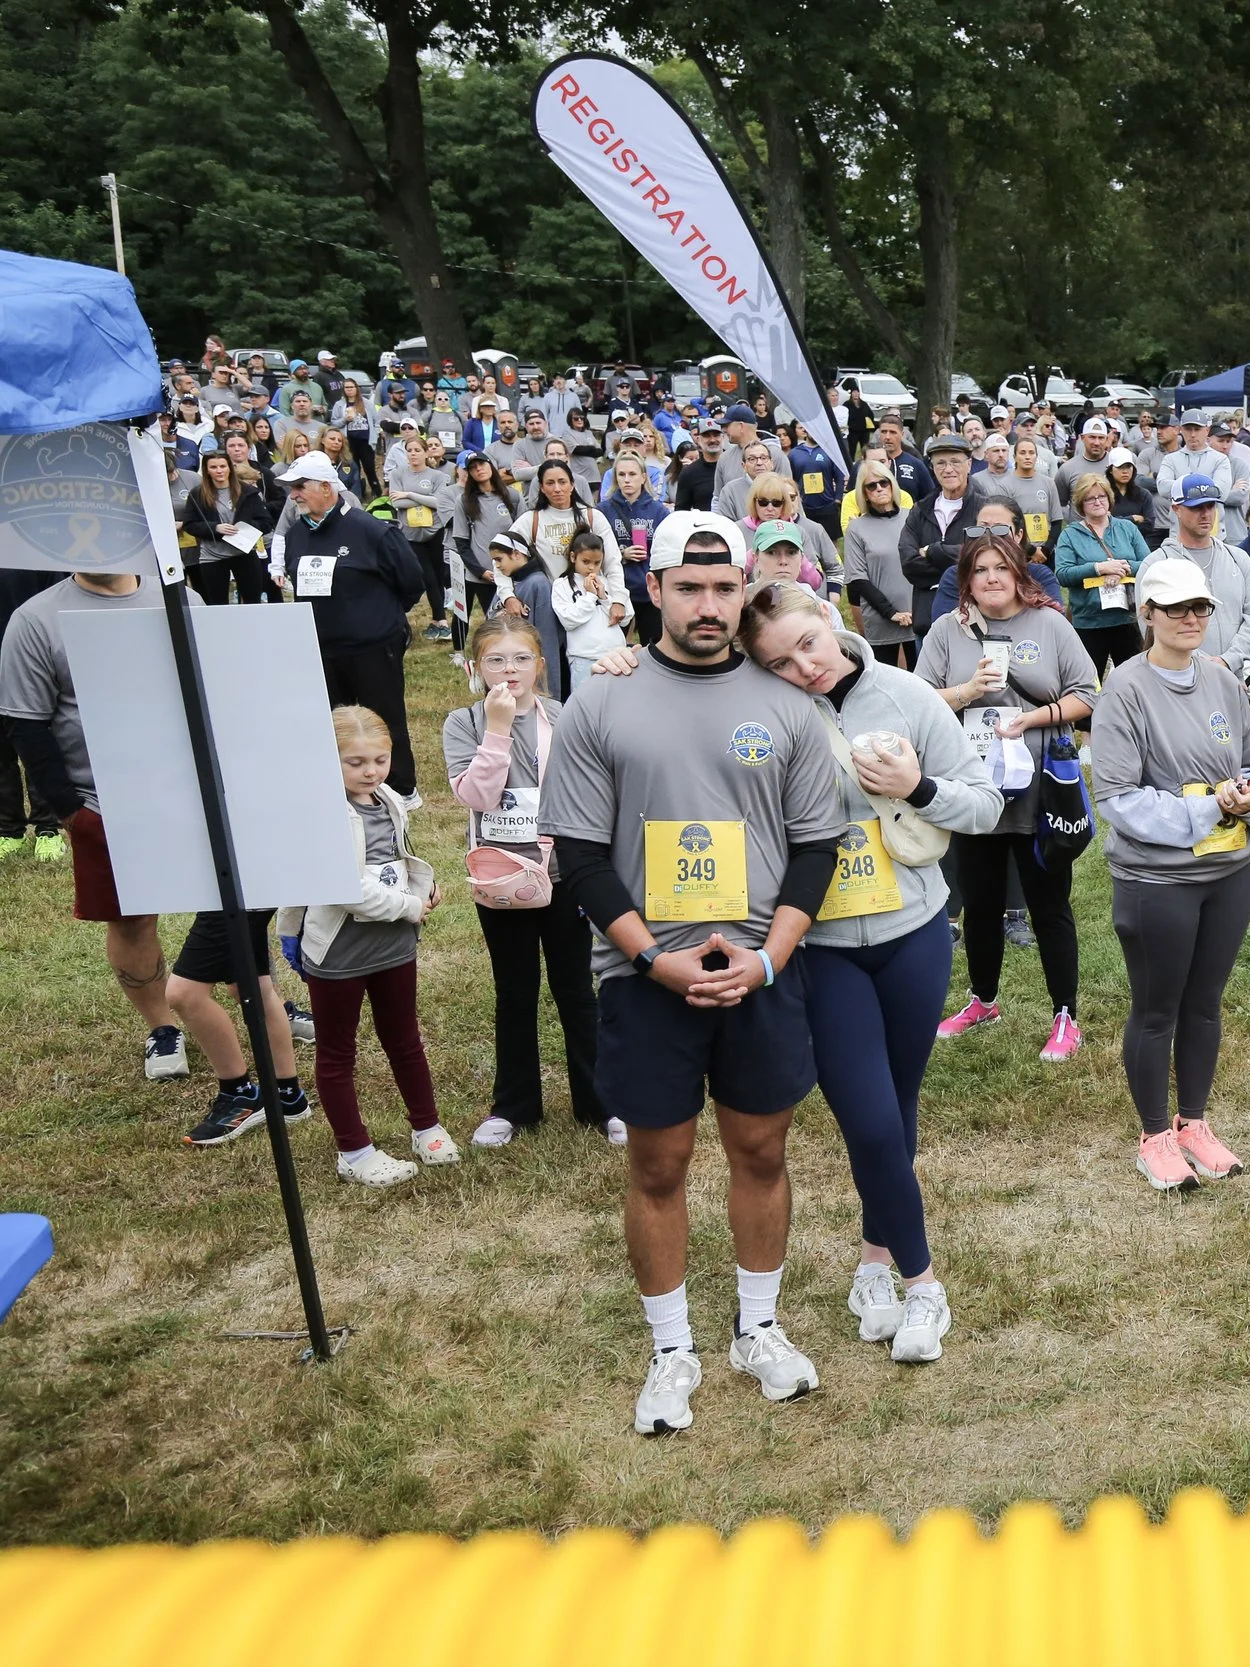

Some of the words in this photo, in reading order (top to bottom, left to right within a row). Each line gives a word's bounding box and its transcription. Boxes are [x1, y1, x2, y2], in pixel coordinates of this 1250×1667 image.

[551, 74, 748, 305] REGISTRATION
[544, 522, 567, 538] NOTRE
[775, 521, 784, 532] B
[747, 739, 771, 748] STRONG
[483, 813, 497, 824] SAK
[677, 858, 716, 882] 349
[838, 854, 875, 880] 348
[683, 883, 719, 891] DUFFY
[847, 879, 878, 888] DUFFY
